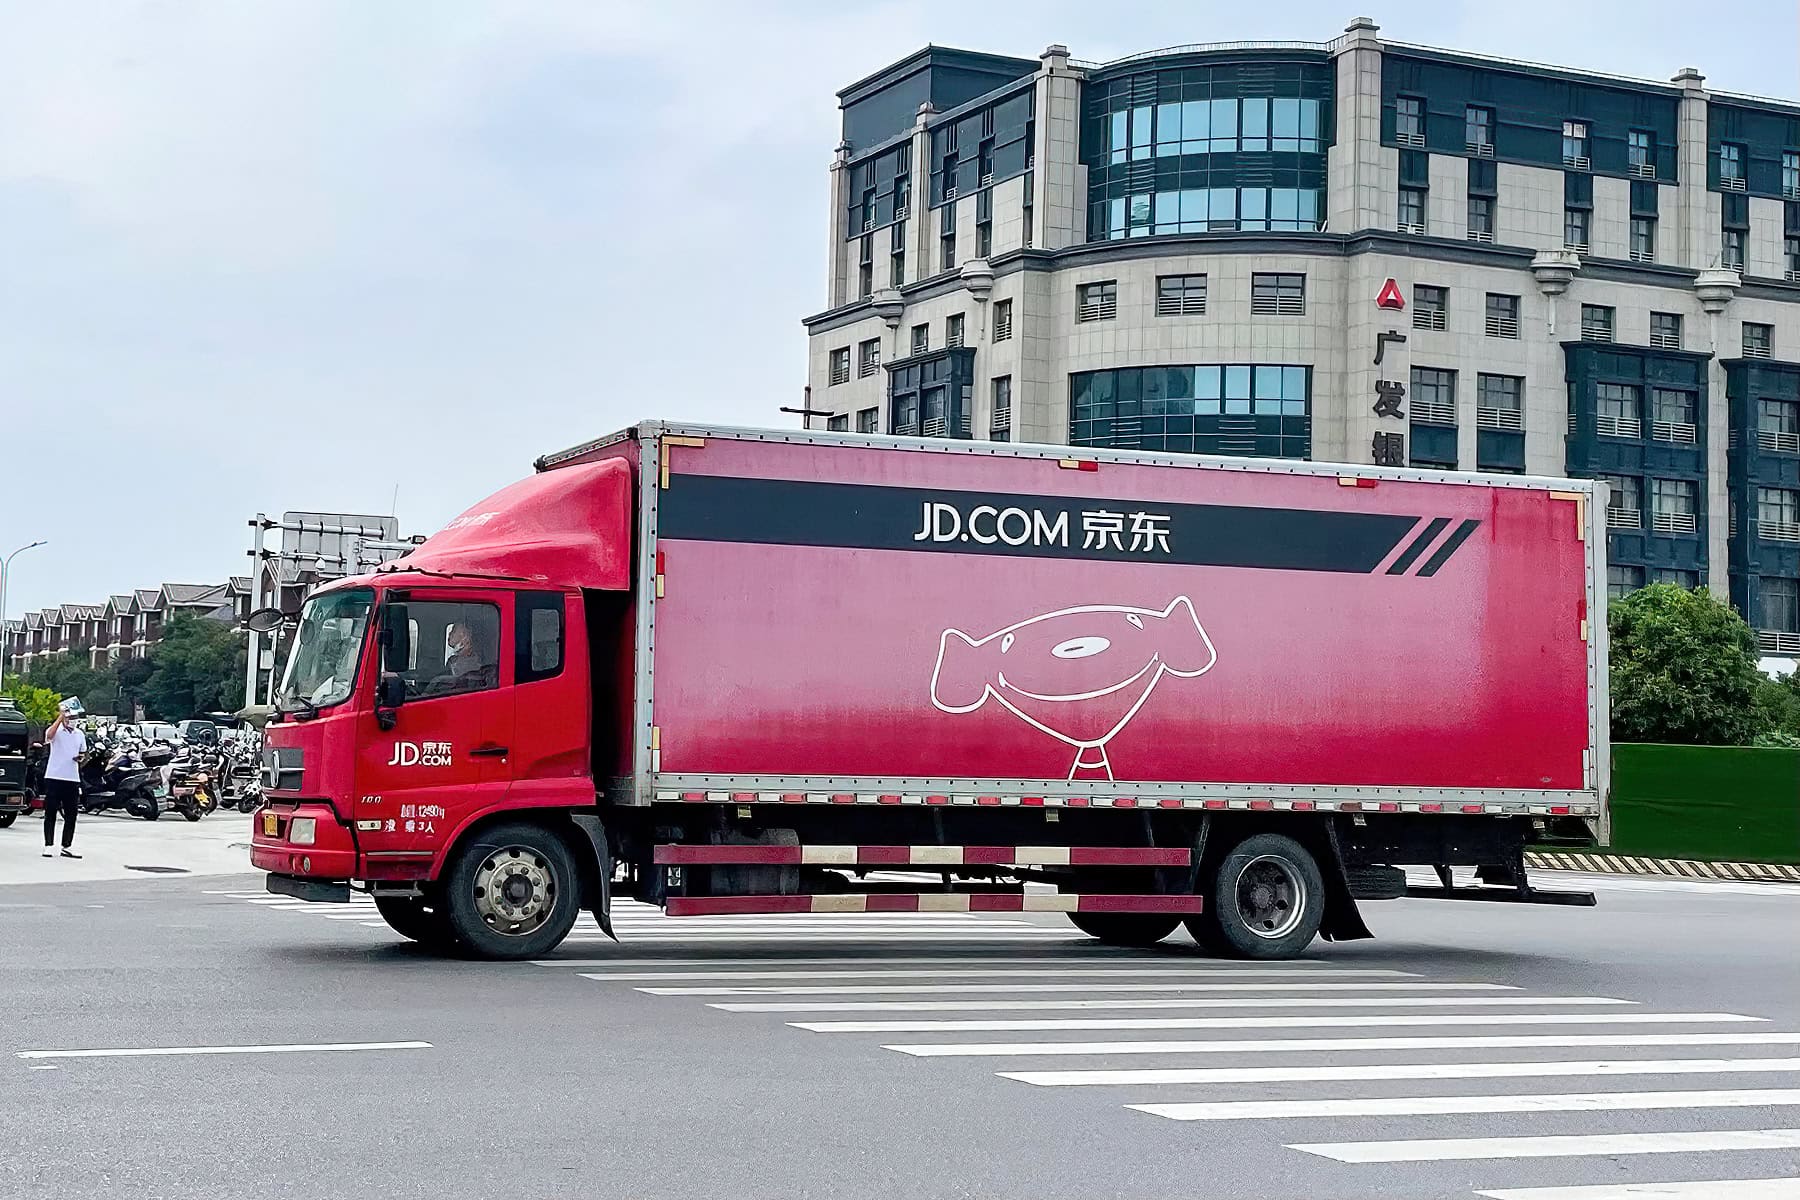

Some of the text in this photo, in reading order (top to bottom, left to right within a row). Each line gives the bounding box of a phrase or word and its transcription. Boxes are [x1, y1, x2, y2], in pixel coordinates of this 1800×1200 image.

[914, 502, 1171, 553] JD.COM 京东
[422, 742, 452, 755] 京东
